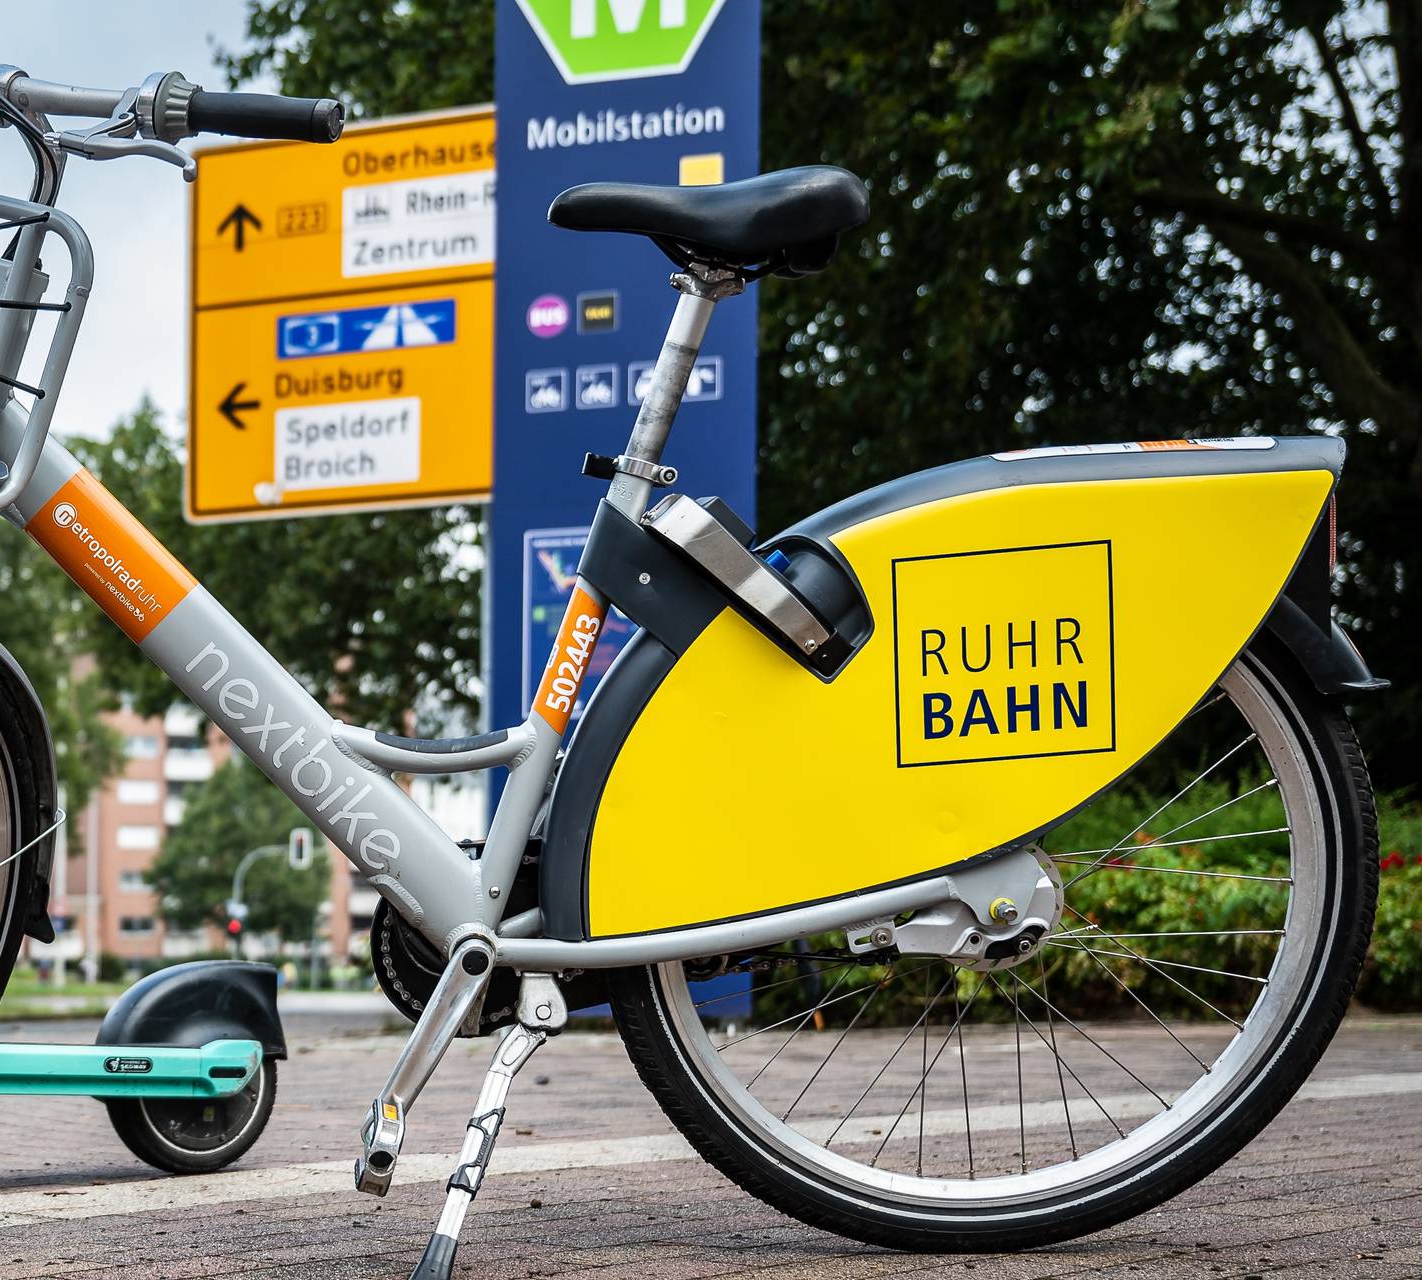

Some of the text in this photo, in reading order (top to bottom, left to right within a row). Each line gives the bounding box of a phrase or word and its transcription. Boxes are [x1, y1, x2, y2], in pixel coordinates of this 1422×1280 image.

[527, 103, 725, 150] Mobilstation
[284, 209, 322, 232] 223
[353, 233, 478, 267] Zentrum
[529, 305, 568, 328] BUS
[307, 325, 319, 347] 3
[275, 367, 404, 399] Duisburg
[286, 409, 409, 447] Speldorf
[285, 452, 375, 481] Broich
[105, 581, 135, 612] nextbike
[545, 614, 600, 713] 502443
[921, 617, 1084, 676] RUHR
[923, 680, 1088, 740] BAHN
[185, 641, 401, 870] nextbike
